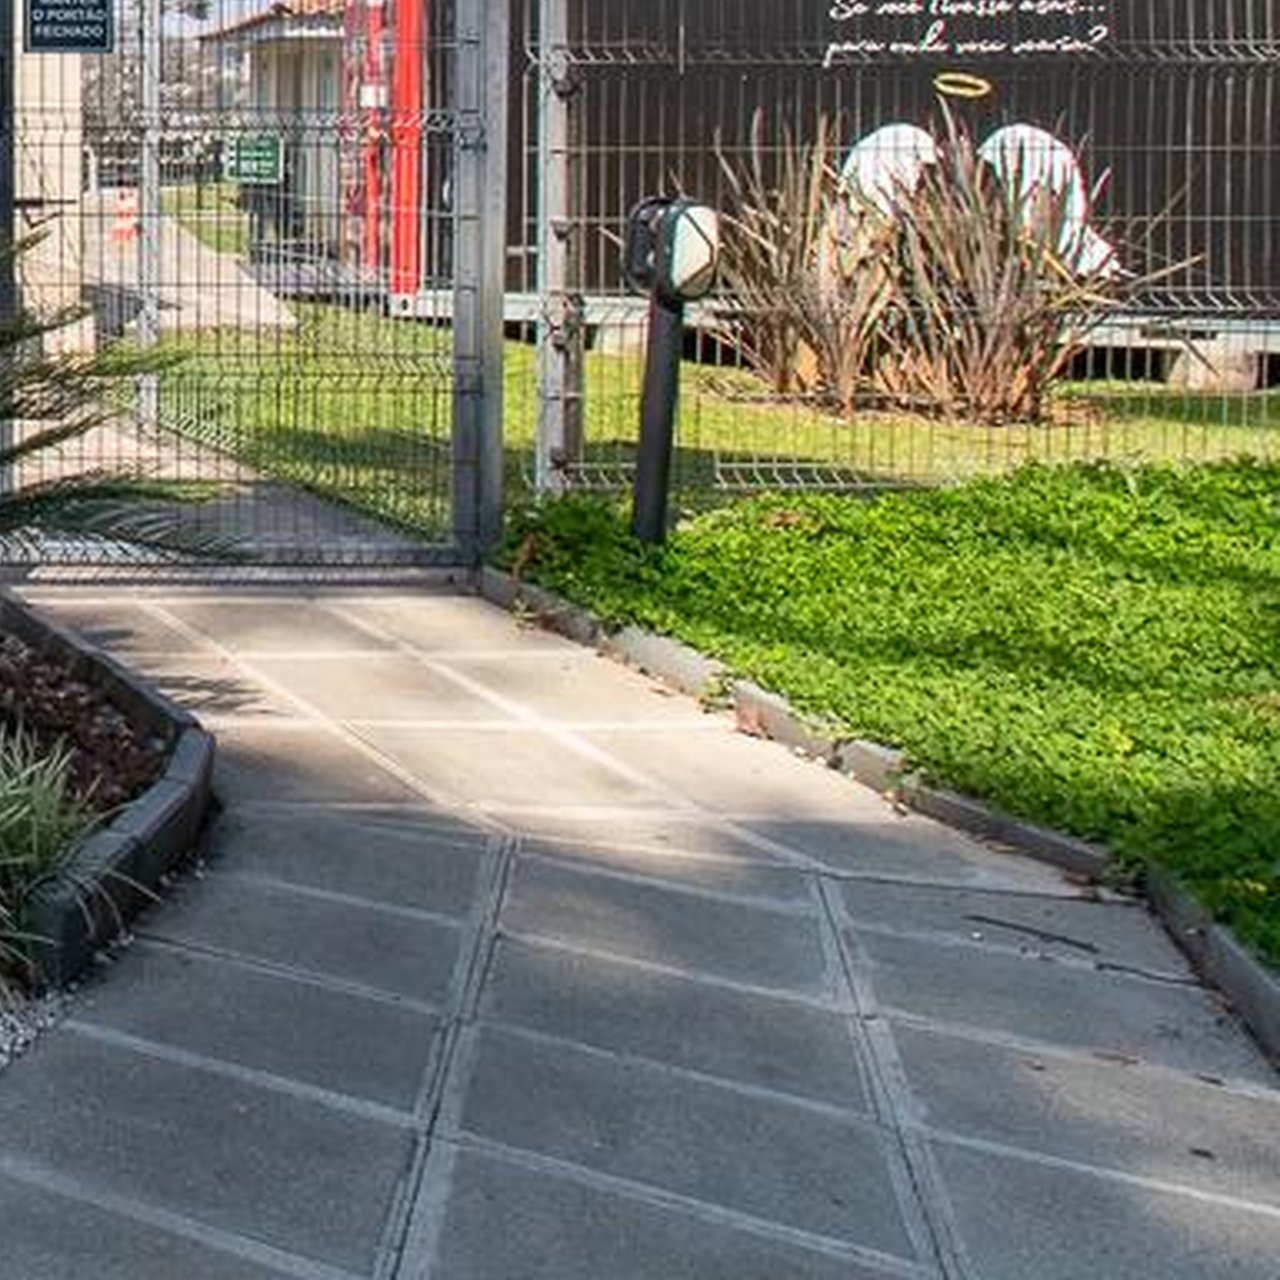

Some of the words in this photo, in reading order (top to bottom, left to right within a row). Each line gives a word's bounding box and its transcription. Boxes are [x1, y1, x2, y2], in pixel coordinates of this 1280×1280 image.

[32, 9, 44, 21] O
[46, 6, 107, 21] PORTÃO
[34, 24, 104, 38] FECHADO
